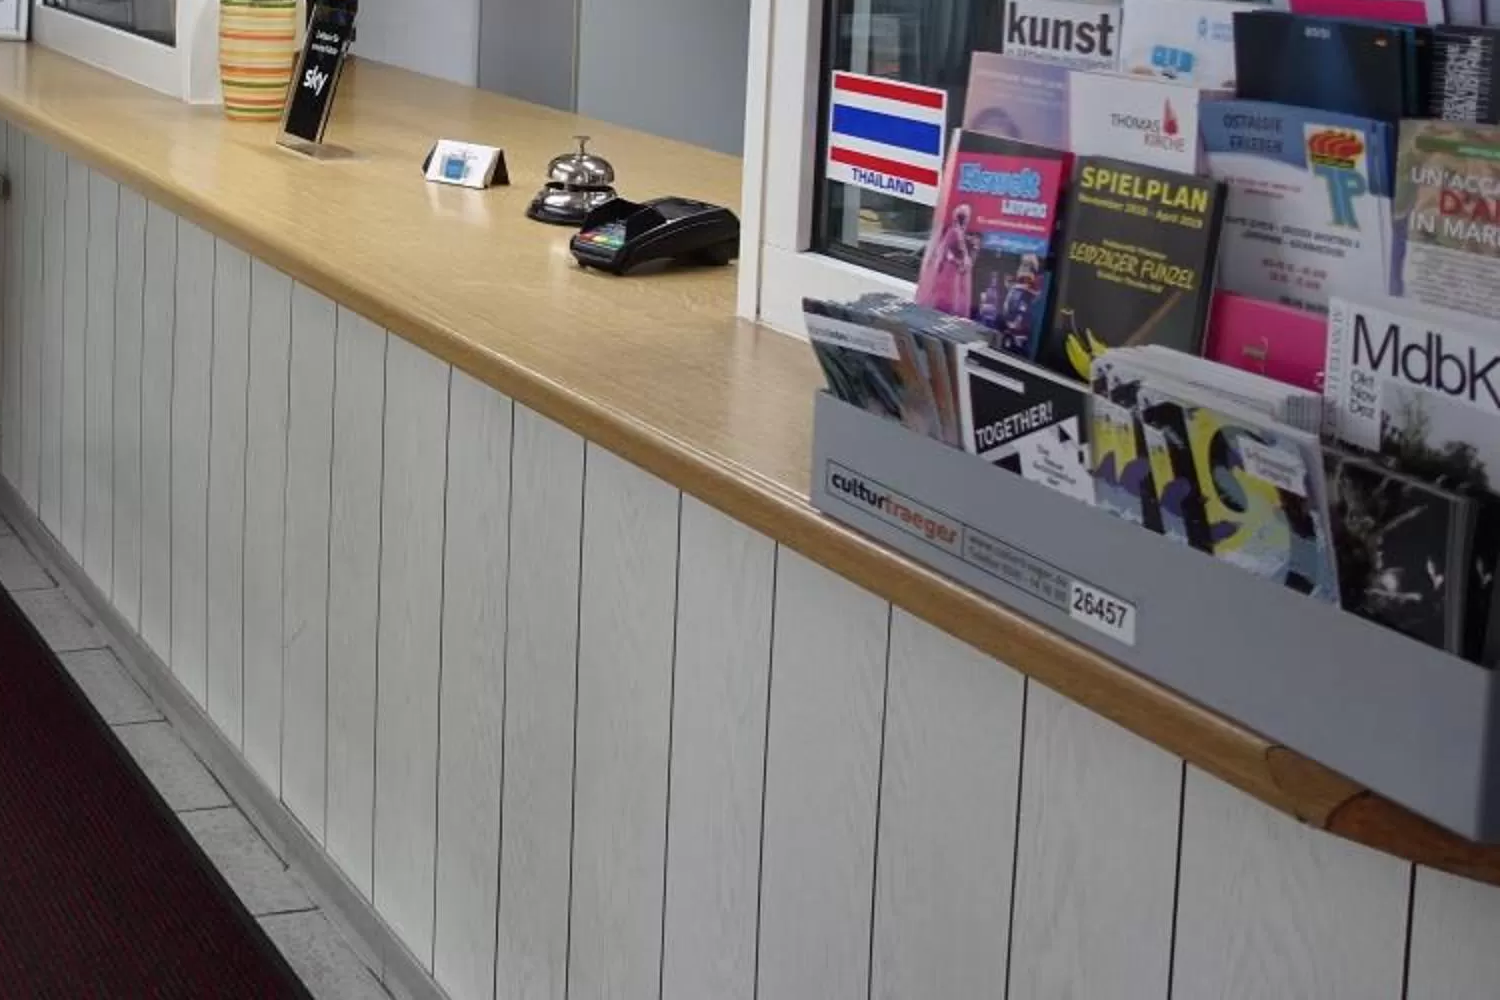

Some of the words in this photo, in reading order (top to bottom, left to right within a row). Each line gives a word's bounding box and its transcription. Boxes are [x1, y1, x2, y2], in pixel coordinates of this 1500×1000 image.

[1007, 1, 1114, 57] kunst
[303, 65, 329, 96] sky
[851, 167, 915, 196] THAILAND
[1080, 167, 1209, 213] SPIELPLAN
[1410, 211, 1436, 233] IN
[1353, 313, 1500, 411] MdbK
[976, 400, 1054, 451] TOGETHER!
[831, 471, 958, 546] culturtraeger
[1072, 586, 1128, 630] 26457
